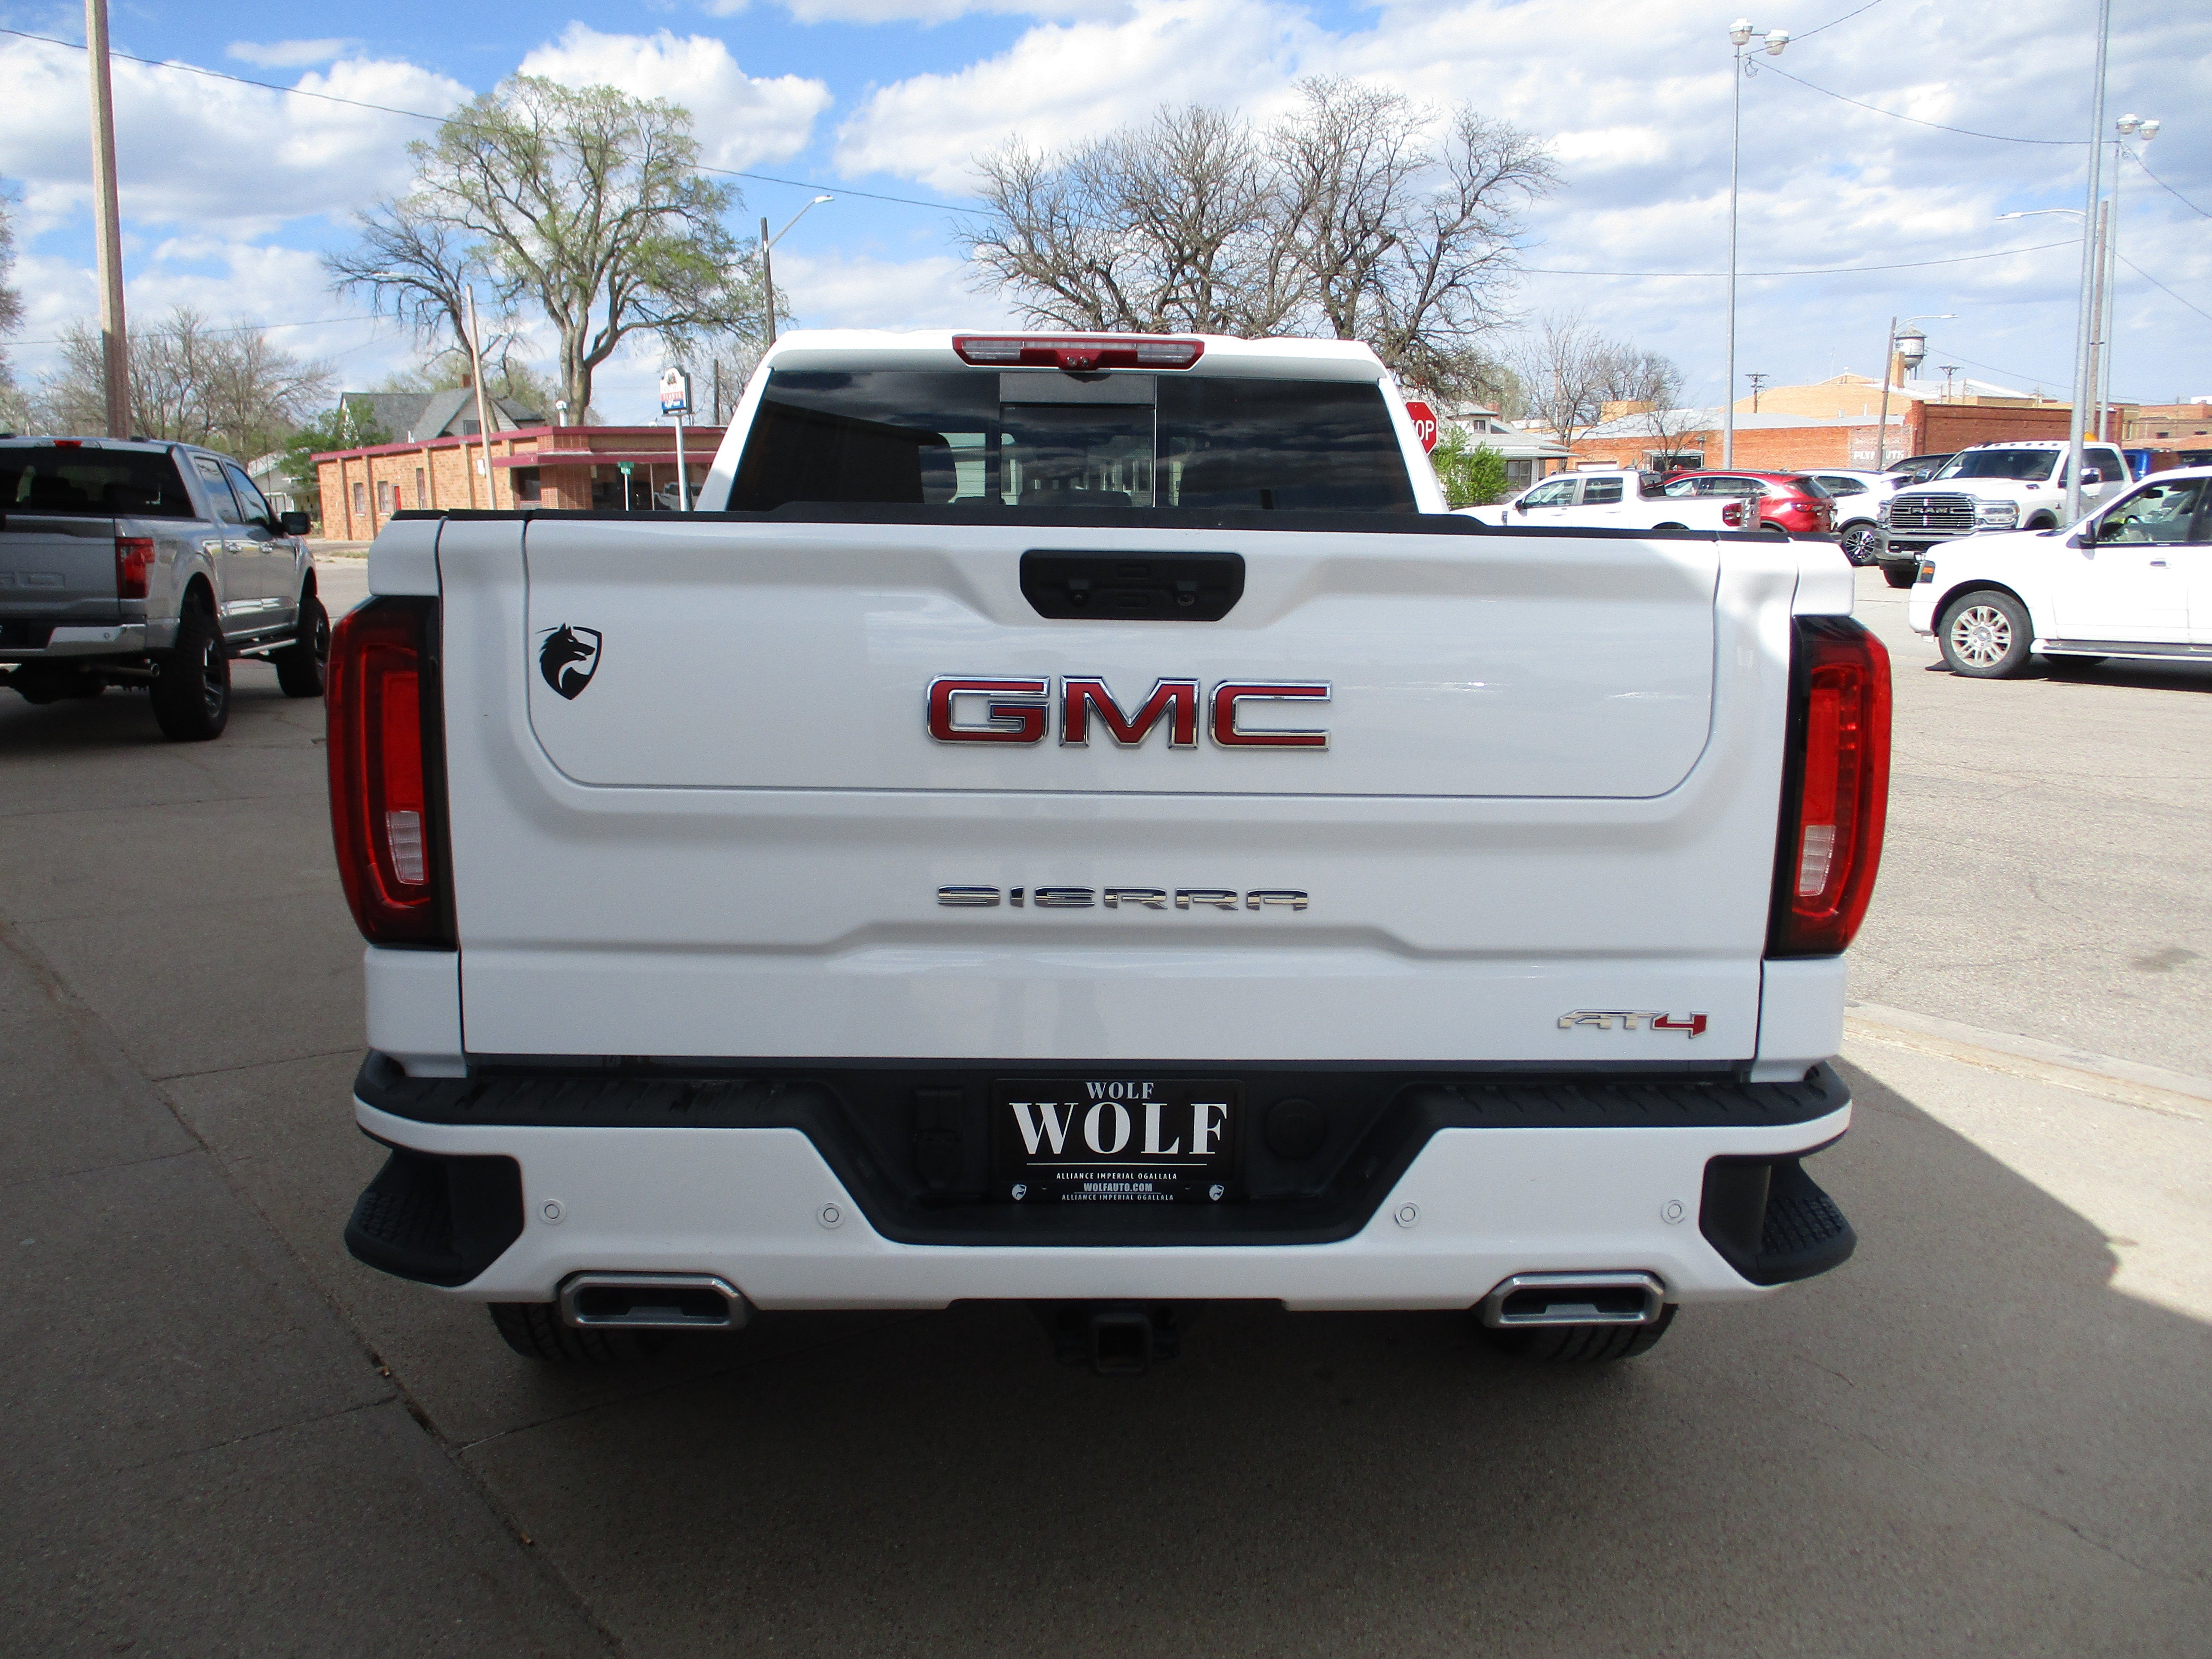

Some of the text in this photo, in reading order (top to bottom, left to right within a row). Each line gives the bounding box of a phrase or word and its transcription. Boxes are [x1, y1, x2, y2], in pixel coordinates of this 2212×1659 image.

[1412, 419, 1434, 441] OP
[1853, 451, 1904, 460] PLYUTH
[927, 675, 1333, 751] GMC
[938, 884, 1309, 911] SIERRA
[1557, 1009, 1709, 1039] AT4
[1085, 1082, 1155, 1100] WOLF
[1009, 1102, 1228, 1155] WOLF
[1083, 1183, 1152, 1192] WOLFAUTO.COM
